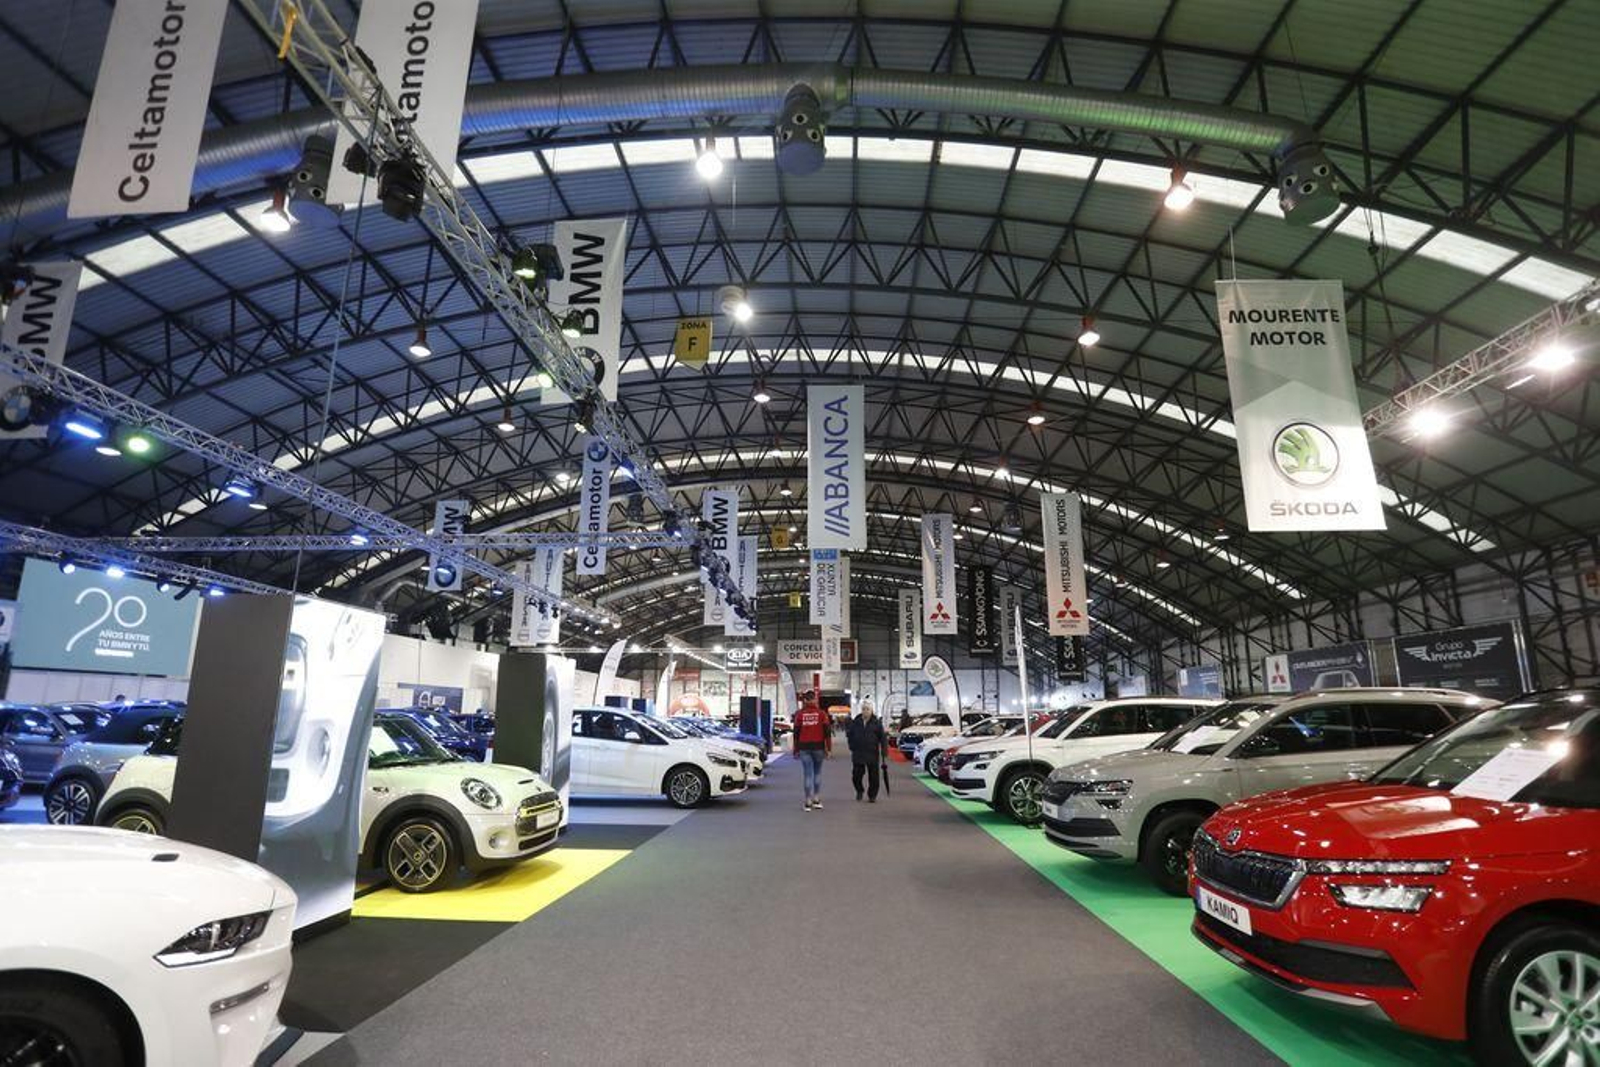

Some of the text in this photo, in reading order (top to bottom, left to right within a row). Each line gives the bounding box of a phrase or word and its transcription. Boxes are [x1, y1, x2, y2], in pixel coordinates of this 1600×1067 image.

[397, 1, 436, 127] tamoto
[118, 0, 186, 203] Celtamotor
[569, 232, 605, 335] BMW
[681, 321, 707, 330] ZONA
[1229, 309, 1341, 324] MOURENTE
[688, 336, 698, 351] F
[1250, 331, 1327, 346] MOTOR
[584, 468, 603, 569] Ceamotor
[712, 497, 729, 551] BMW
[1270, 500, 1358, 517] ŠKODA
[1056, 499, 1071, 593] MITSUBISHI MOTORS
[817, 563, 825, 618] DE GALICIA
[827, 563, 836, 596] XUNTA
[975, 569, 985, 636] SSANGYONG
[66, 587, 147, 652] 20
[906, 595, 914, 648] SUBARU
[732, 650, 748, 658] KIA
[789, 652, 800, 660] DE
[1431, 650, 1473, 662] Invicta
[1435, 641, 1463, 651] Grupo
[1207, 896, 1239, 925] KAMIQ
